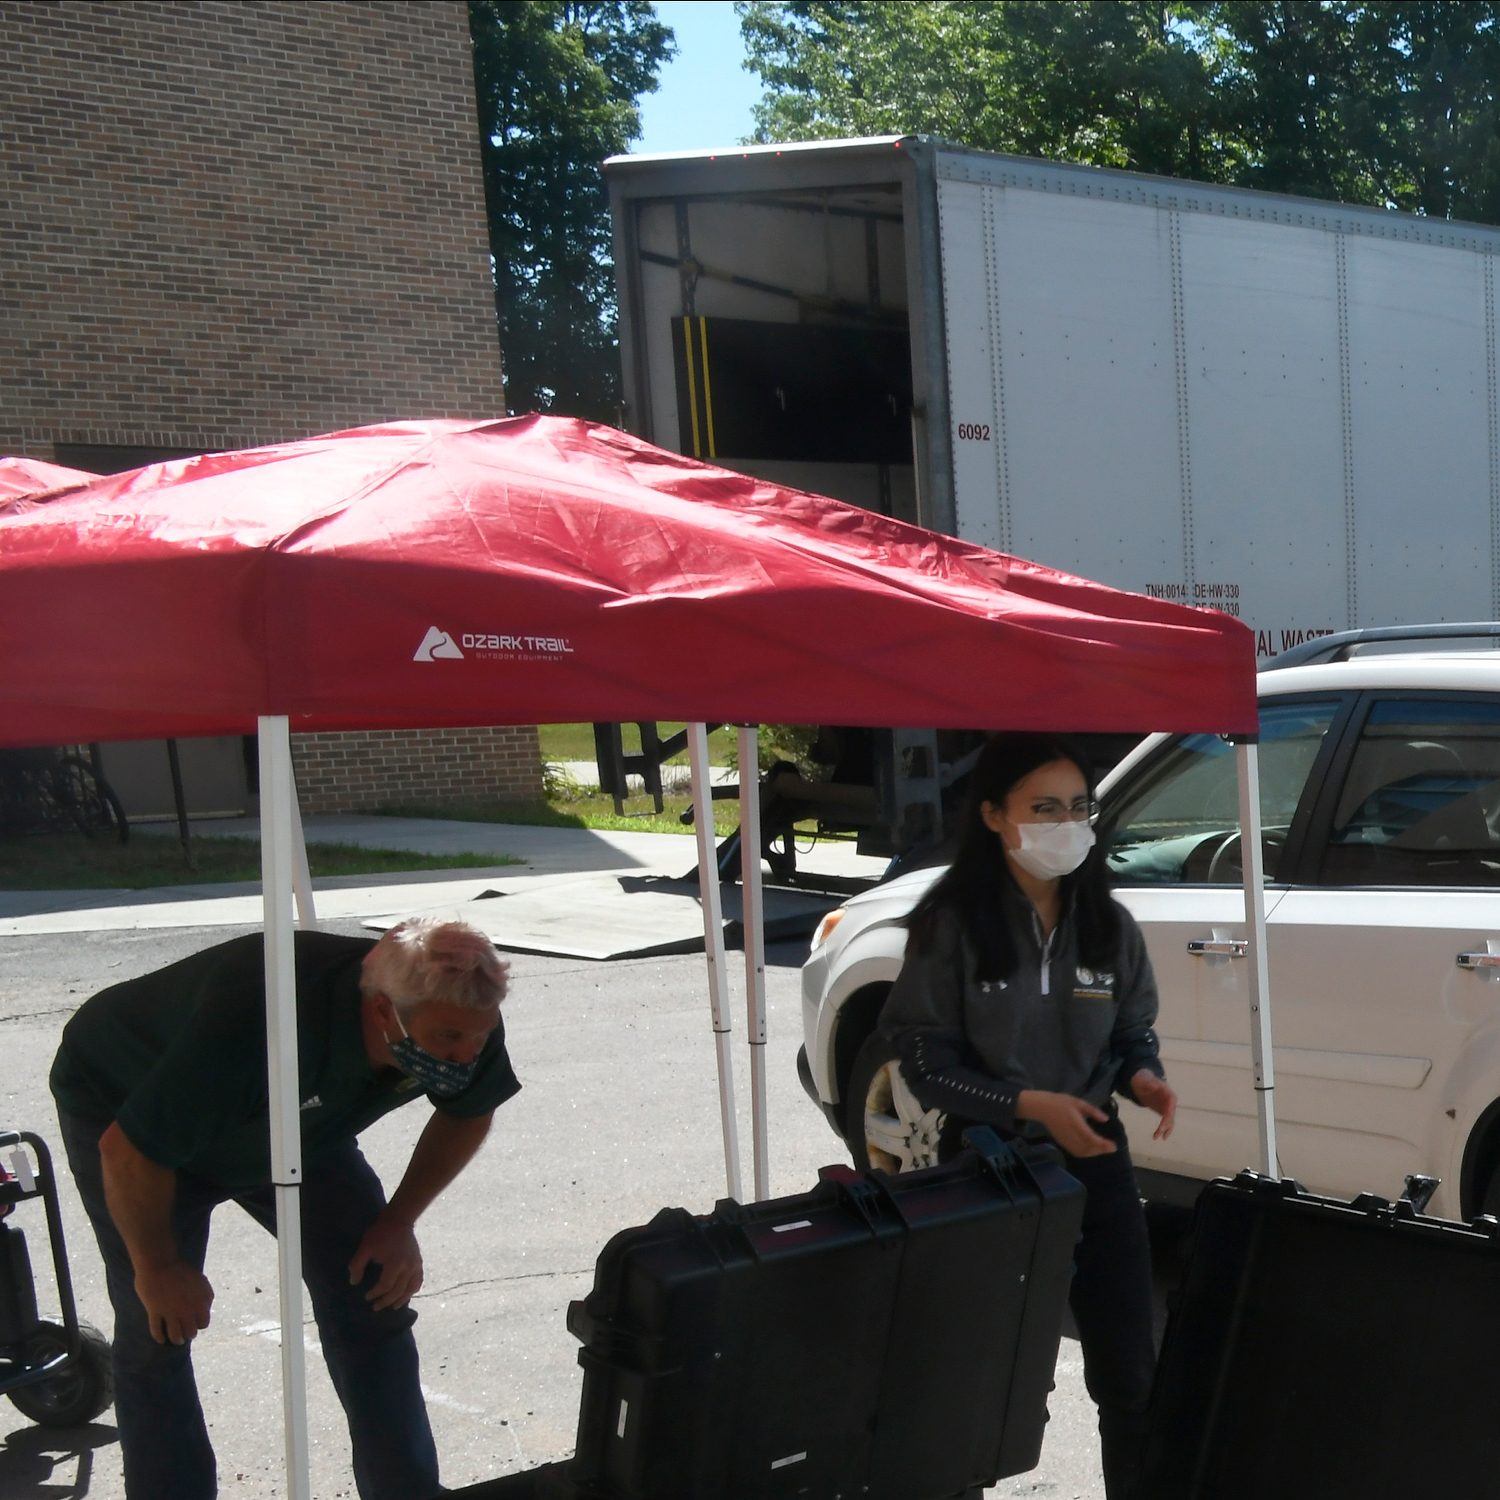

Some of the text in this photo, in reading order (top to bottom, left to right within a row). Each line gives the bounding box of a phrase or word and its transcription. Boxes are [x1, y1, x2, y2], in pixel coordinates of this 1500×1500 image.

[958, 423, 990, 441] 6092
[462, 634, 574, 652] OZARK TRAIL
[517, 654, 563, 662] EQUIPMENT
